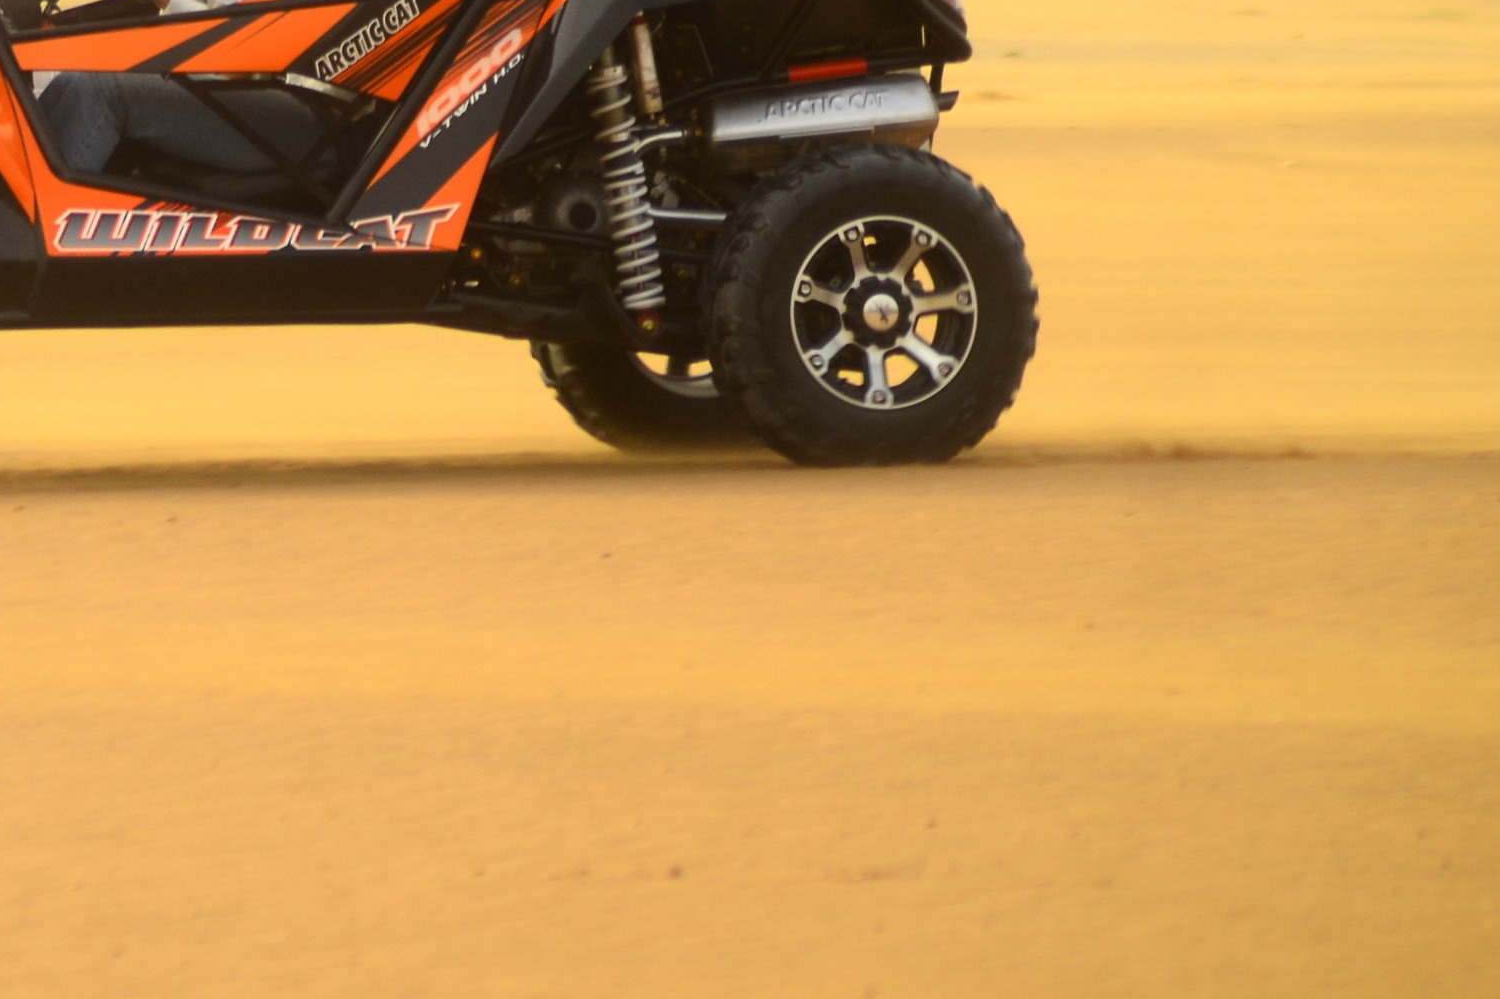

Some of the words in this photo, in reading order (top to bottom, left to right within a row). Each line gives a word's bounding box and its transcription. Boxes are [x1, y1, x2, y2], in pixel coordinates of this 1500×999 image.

[315, 18, 385, 81] ARCTIC
[417, 27, 523, 139] 1000
[420, 83, 487, 148] V-TWIN
[493, 53, 525, 84] H.O.
[765, 95, 843, 119] ARCTIC
[849, 90, 889, 109] CAT
[53, 202, 461, 252] WILDCAT
